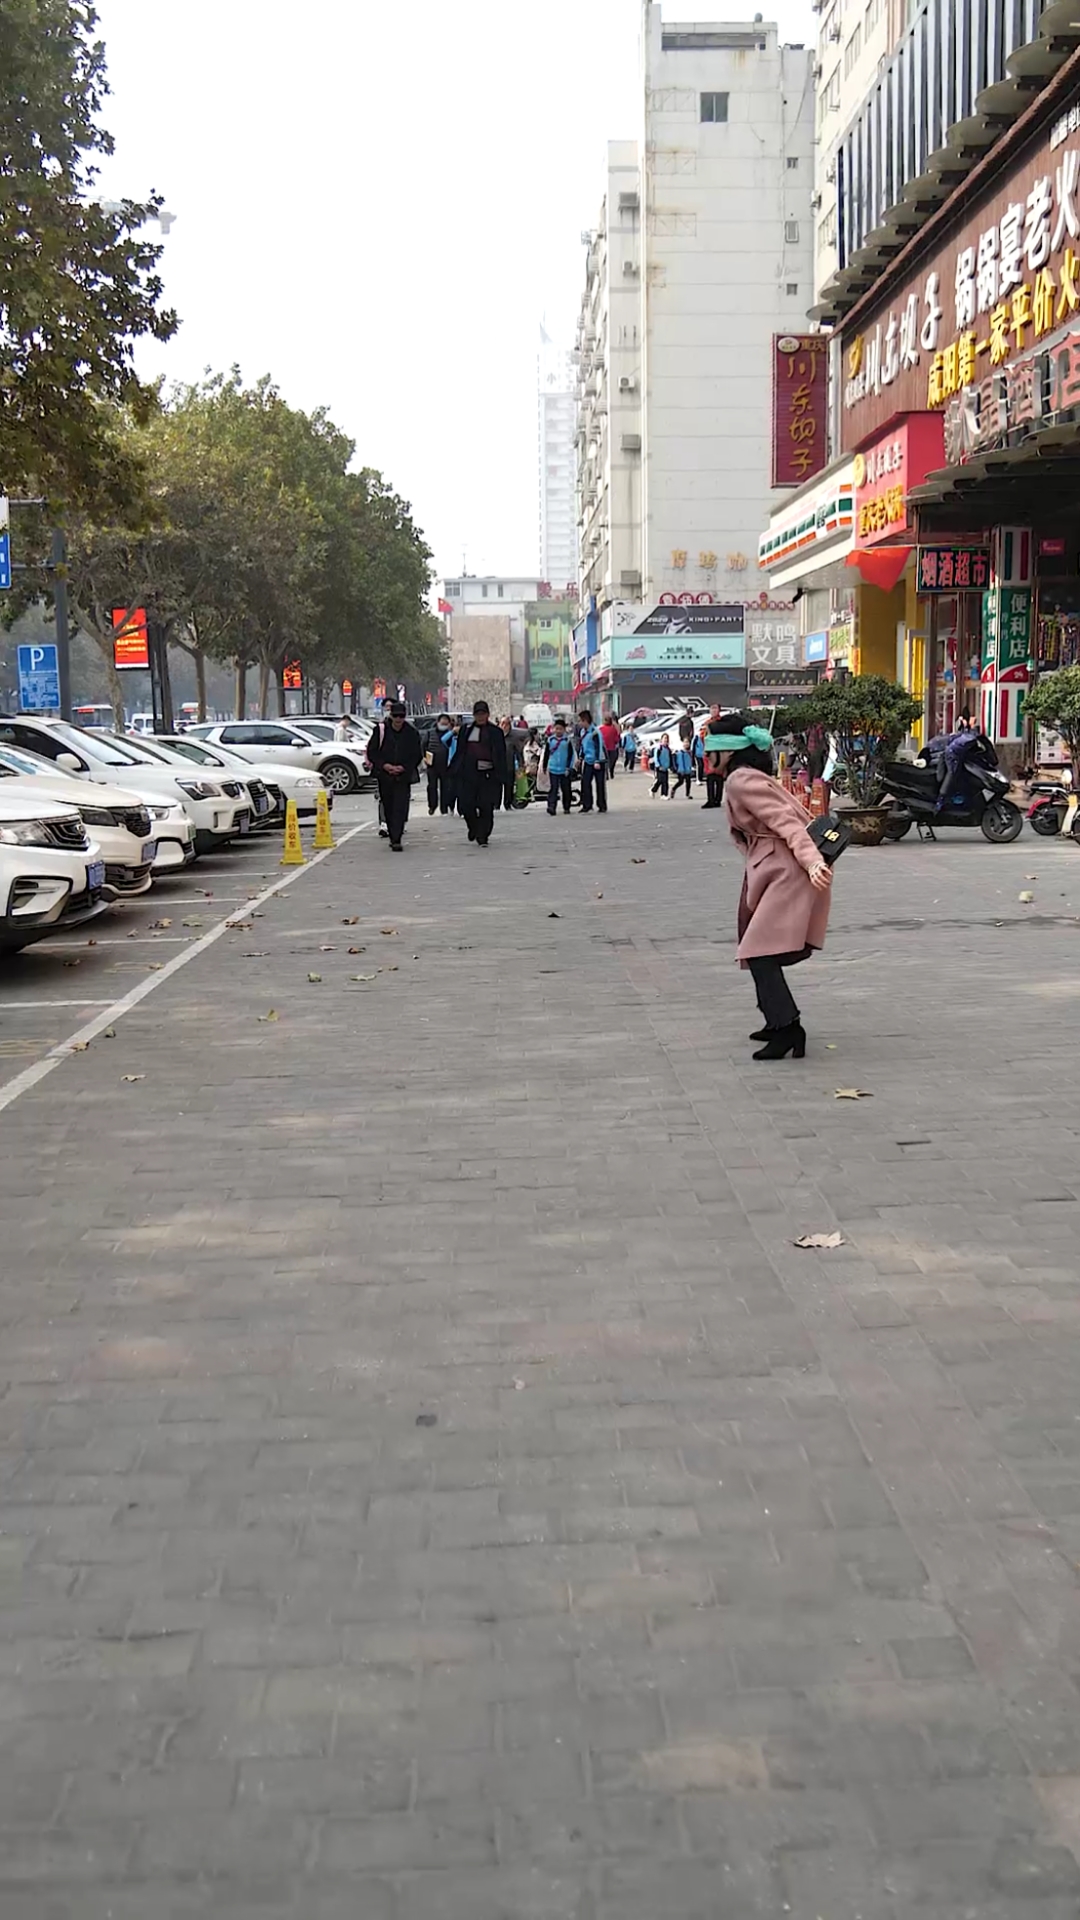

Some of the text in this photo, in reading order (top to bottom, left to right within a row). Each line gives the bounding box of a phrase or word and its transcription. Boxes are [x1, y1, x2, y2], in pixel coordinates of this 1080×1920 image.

[788, 351, 816, 477] 川东坝子
[921, 551, 988, 587] 烟酒超市
[751, 623, 796, 645] 默鸣
[1008, 593, 1027, 659] 便利店
[30, 648, 44, 670] P
[751, 645, 797, 666] 文具
